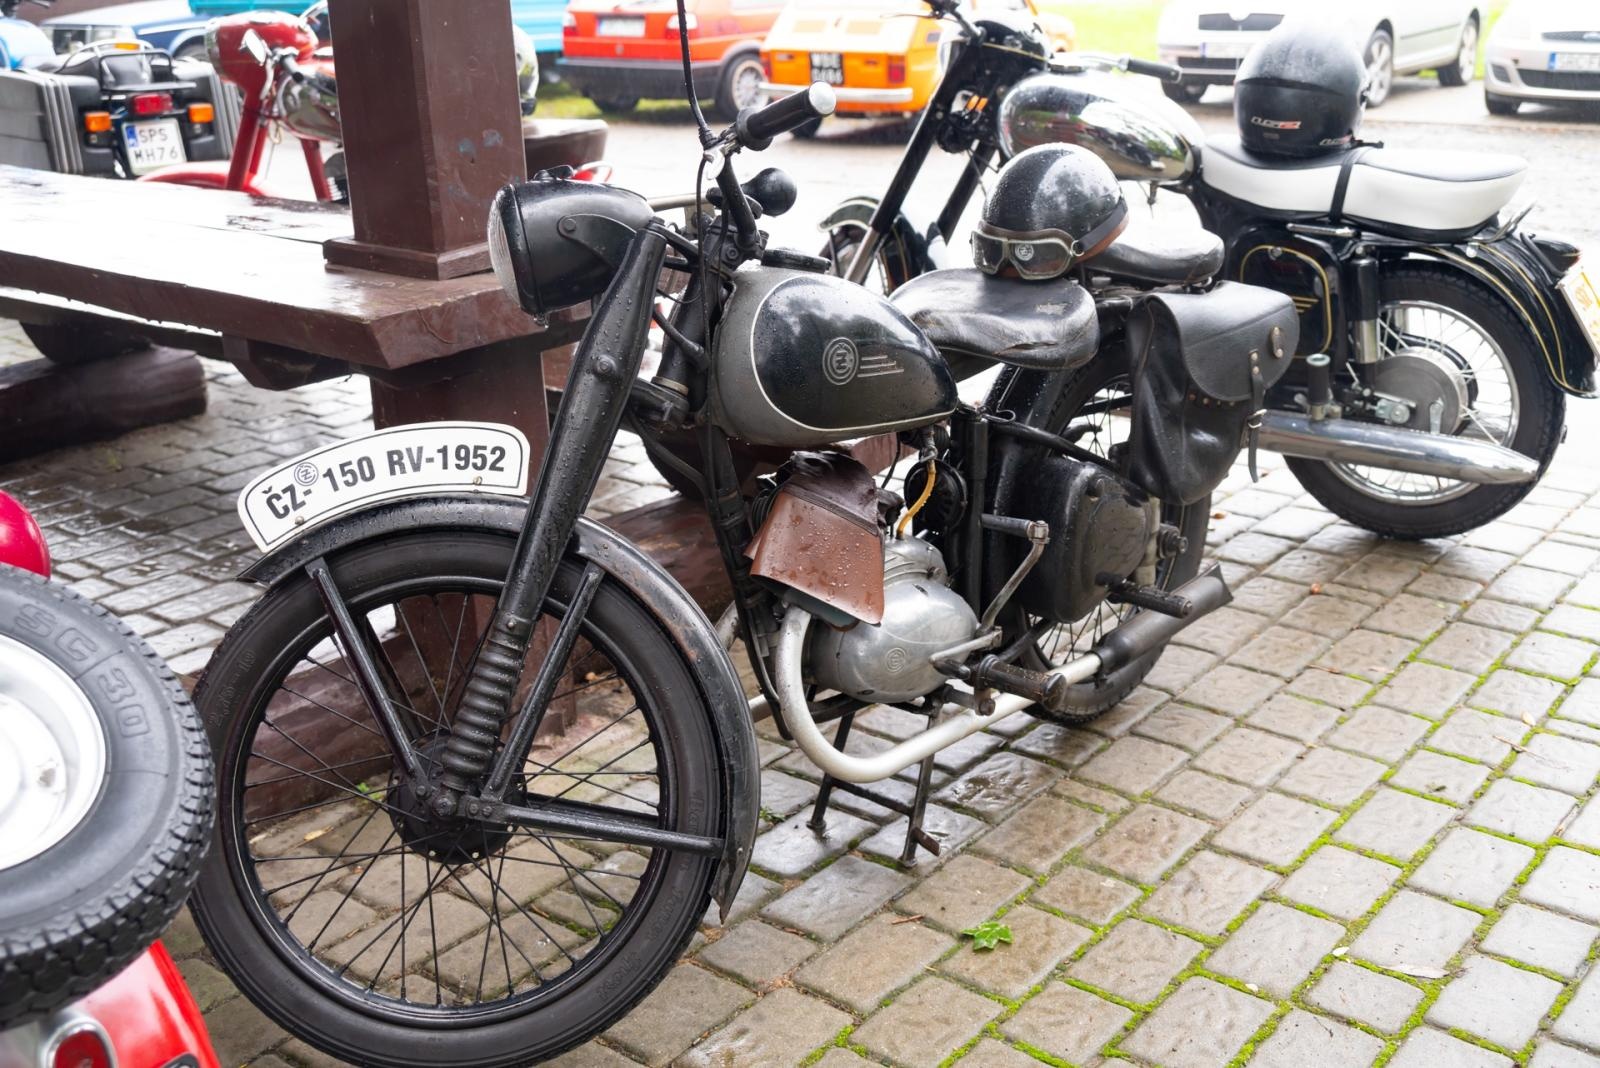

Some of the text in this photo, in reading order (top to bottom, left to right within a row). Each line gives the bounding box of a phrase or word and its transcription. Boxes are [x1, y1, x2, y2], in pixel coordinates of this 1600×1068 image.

[139, 128, 169, 143] SPS
[386, 444, 506, 477] RV-1952
[97, 667, 151, 738] 30
